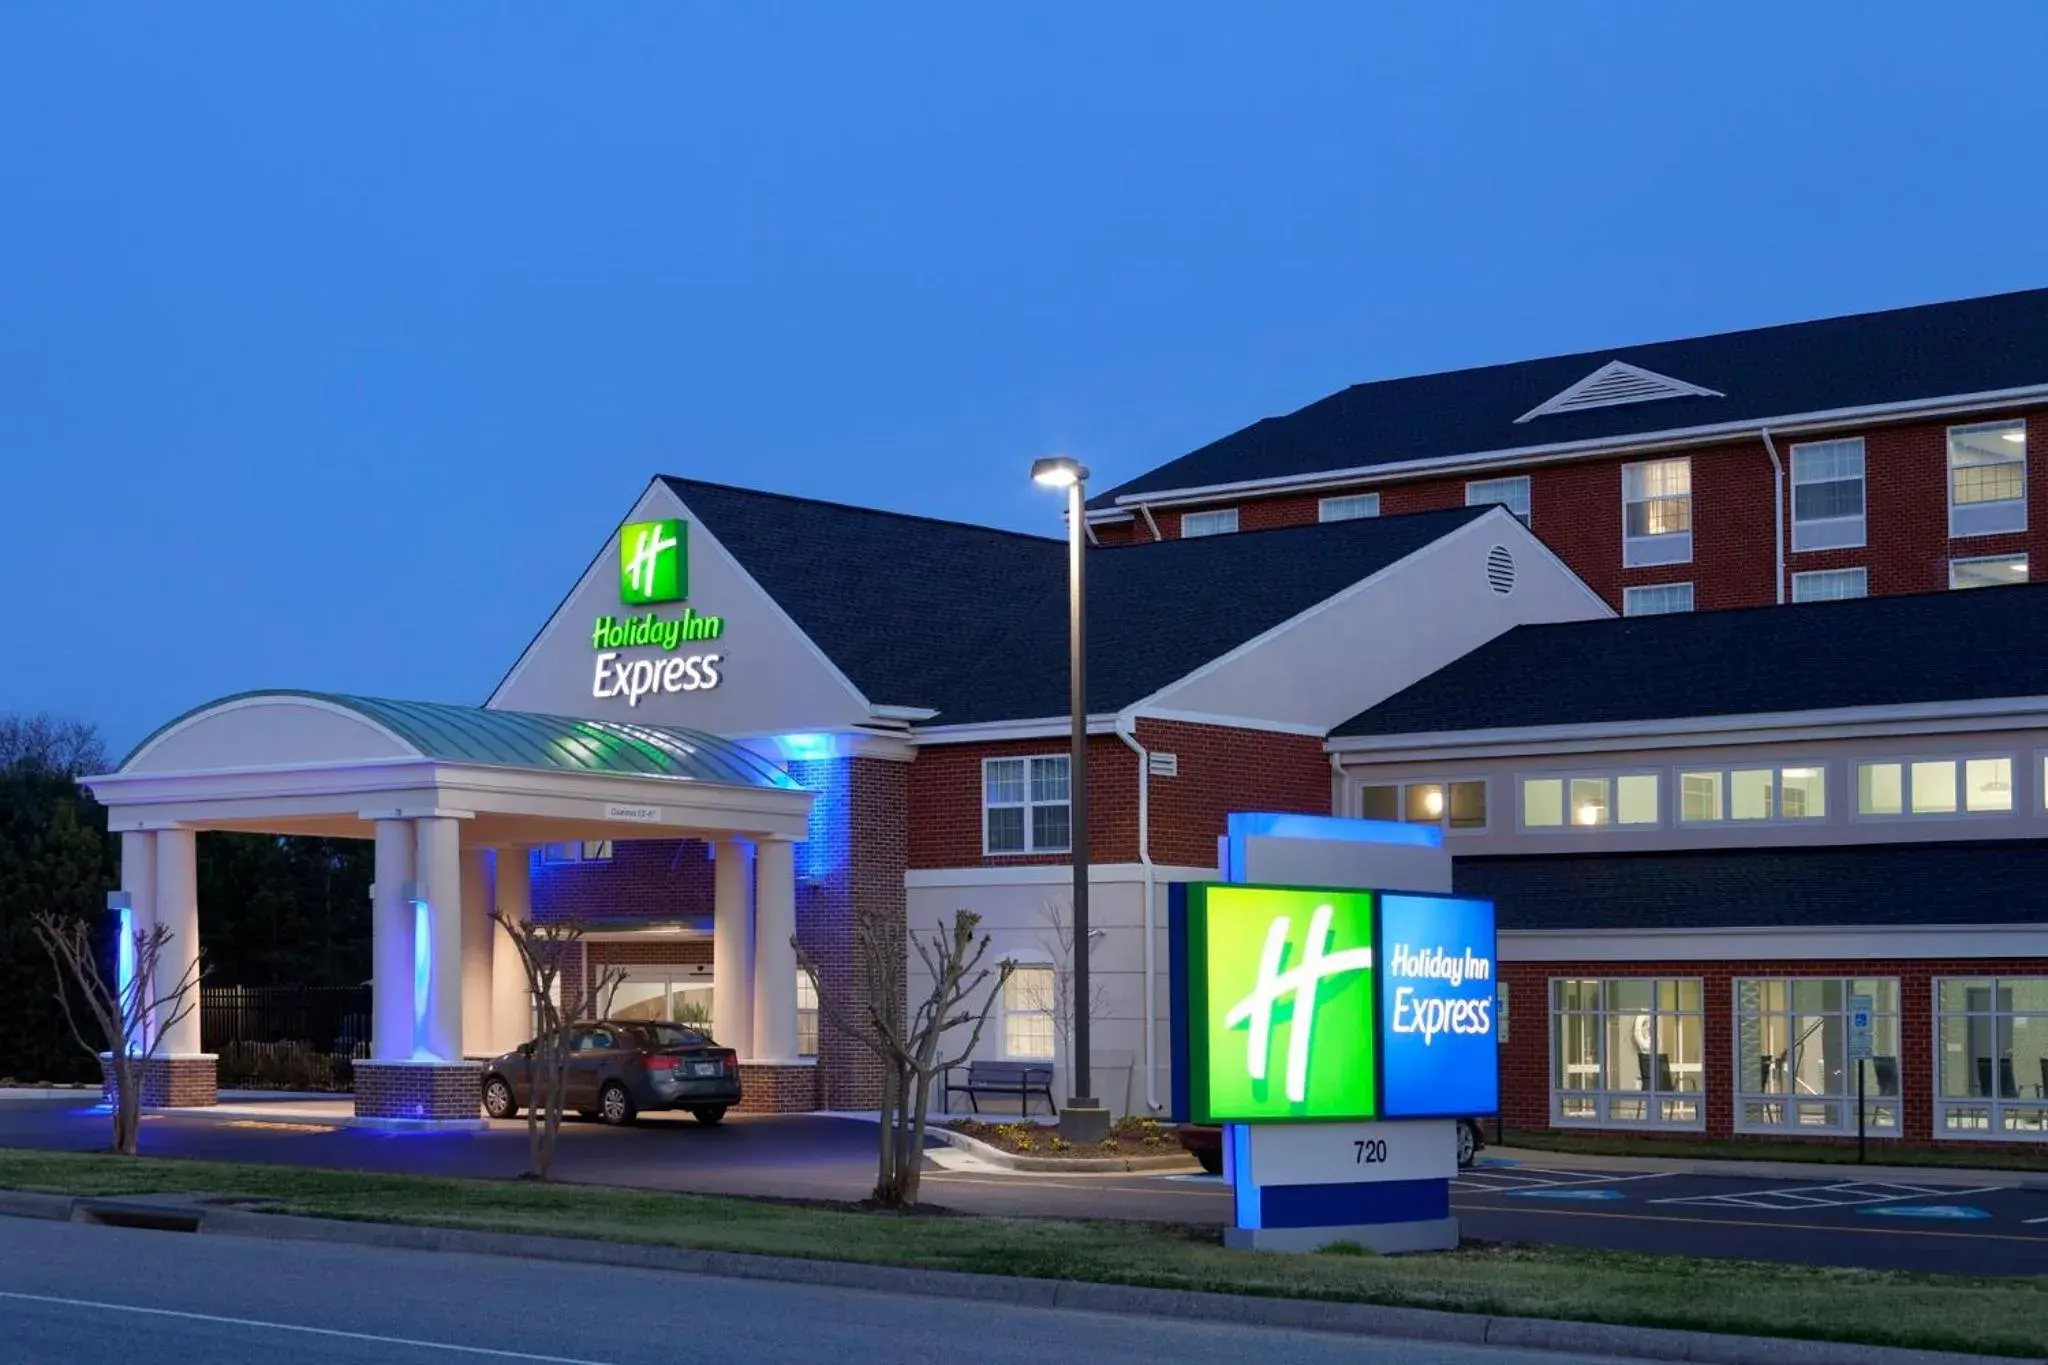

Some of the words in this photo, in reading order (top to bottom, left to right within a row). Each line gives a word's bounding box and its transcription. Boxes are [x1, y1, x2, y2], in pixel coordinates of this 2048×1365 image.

[592, 612, 679, 651] Holiday
[683, 608, 721, 641] Inn
[593, 652, 719, 707] Express
[1391, 943, 1463, 987] Holiday
[1464, 946, 1490, 980] Inn
[1392, 985, 1490, 1046] Express
[1353, 1139, 1387, 1164] 720
